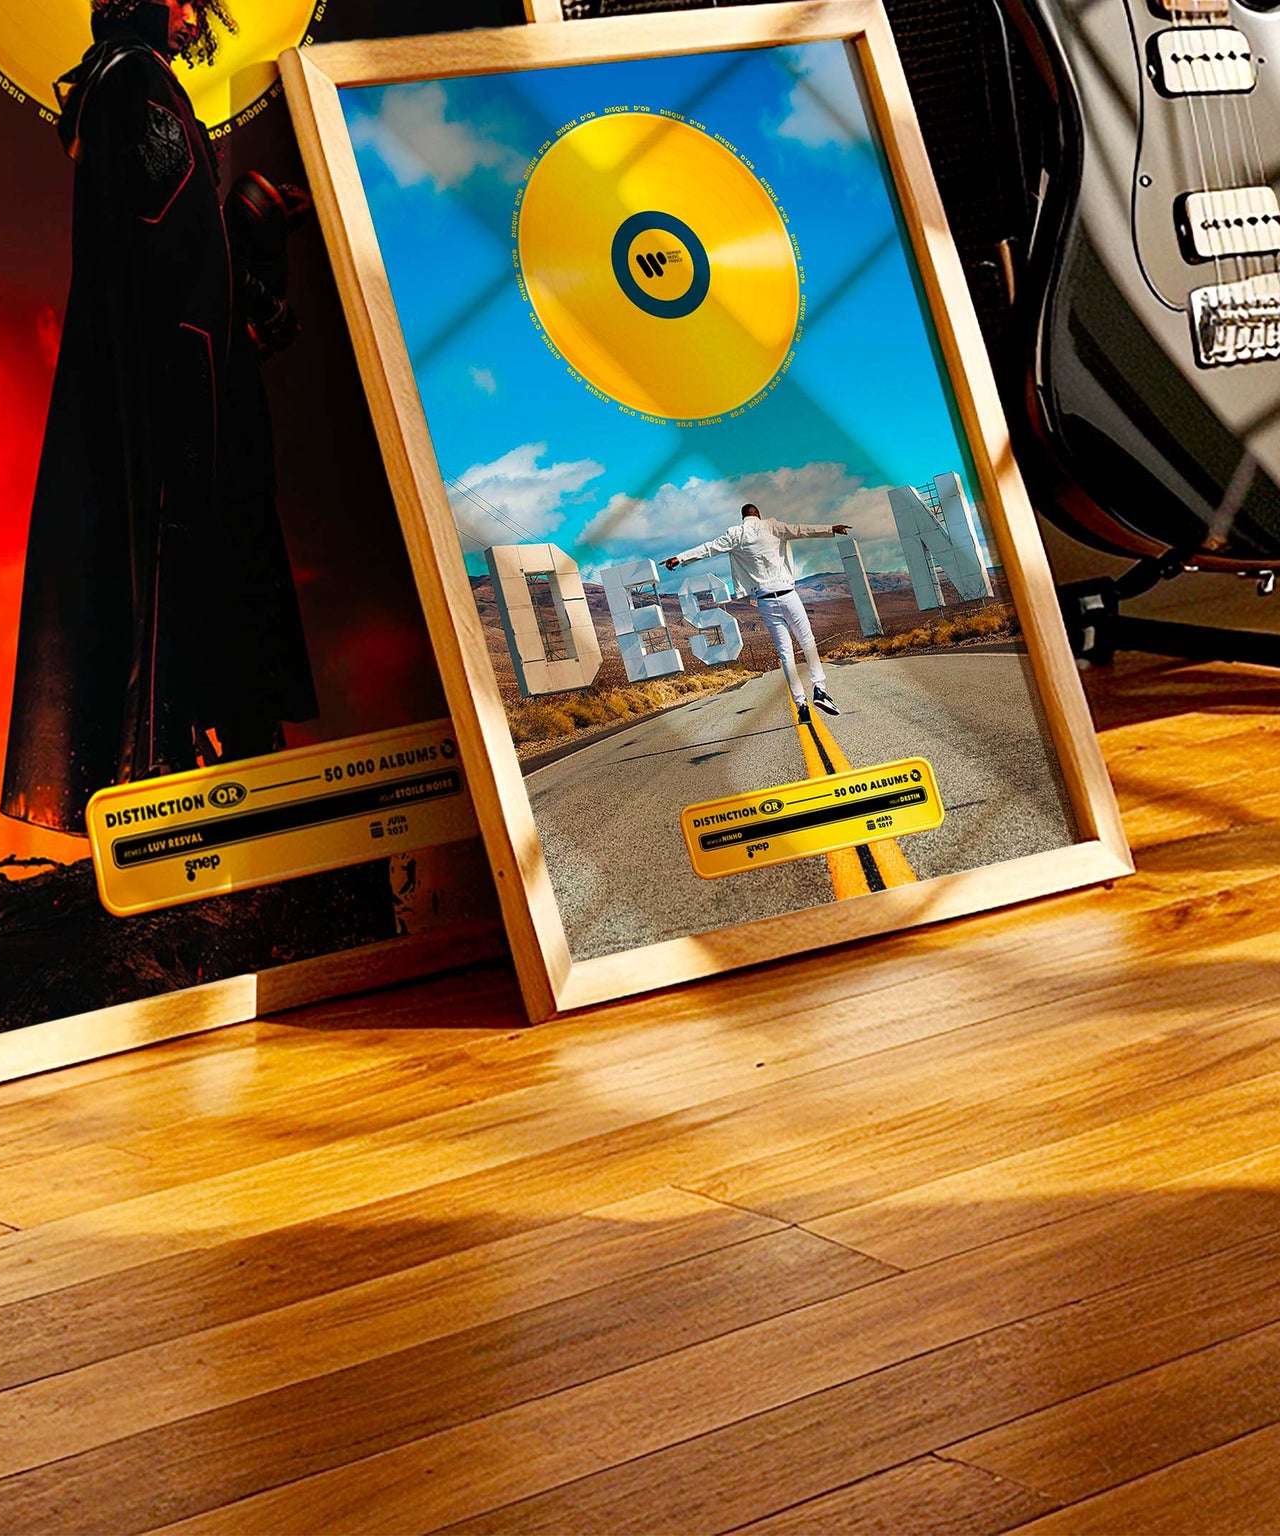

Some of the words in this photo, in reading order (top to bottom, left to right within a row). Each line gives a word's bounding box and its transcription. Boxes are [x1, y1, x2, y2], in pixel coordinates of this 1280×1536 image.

[235, 98, 268, 127] DISQUE
[604, 105, 629, 114] DISQUE
[633, 105, 651, 113] D'OR
[556, 119, 578, 137] DISQUE
[579, 111, 596, 121] D'OR
[659, 109, 686, 122] DISQUE
[689, 119, 706, 131] D'OR
[208, 123, 232, 141] D'OR
[522, 157, 538, 180] DISQUE
[538, 140, 551, 155] D'OR
[713, 133, 738, 154] DISQUE
[739, 154, 755, 171] D'OR
[514, 188, 524, 206] D'OR
[759, 177, 779, 203] DISQUE
[777, 205, 790, 224] D'OR
[511, 210, 520, 239] DISQUE
[511, 248, 520, 269] D'OR
[789, 233, 803, 261] DISQUE
[797, 265, 806, 284] D'OR
[515, 272, 529, 302] DISQUE
[799, 294, 807, 322] DISQUE
[529, 311, 542, 331] D'OR
[793, 325, 803, 343] D'OR
[541, 333, 561, 360] DISQUE
[566, 366, 583, 383] D'OR
[584, 383, 610, 403] DISQUE
[618, 405, 636, 417] D'OR
[640, 414, 667, 425] DISQUE
[105, 794, 205, 827] DISTINCTION
[215, 787, 238, 803] OR
[324, 766, 343, 782] 50
[347, 759, 375, 777] 000
[379, 746, 437, 771] ALBUMS
[693, 807, 757, 828] DISTINCTION
[764, 802, 779, 812] OR
[834, 788, 847, 797] 50
[848, 783, 868, 794] 000
[870, 774, 909, 790] ALBUMS
[900, 793, 920, 802] DESTIN
[387, 816, 407, 826] JUIN
[876, 815, 892, 823] MARS
[878, 820, 893, 829] 2019
[148, 841, 166, 852] LUV
[168, 833, 203, 848] RESVAL
[722, 832, 743, 842] NINHO
[746, 842, 769, 858] snep
[184, 854, 220, 882] snep
